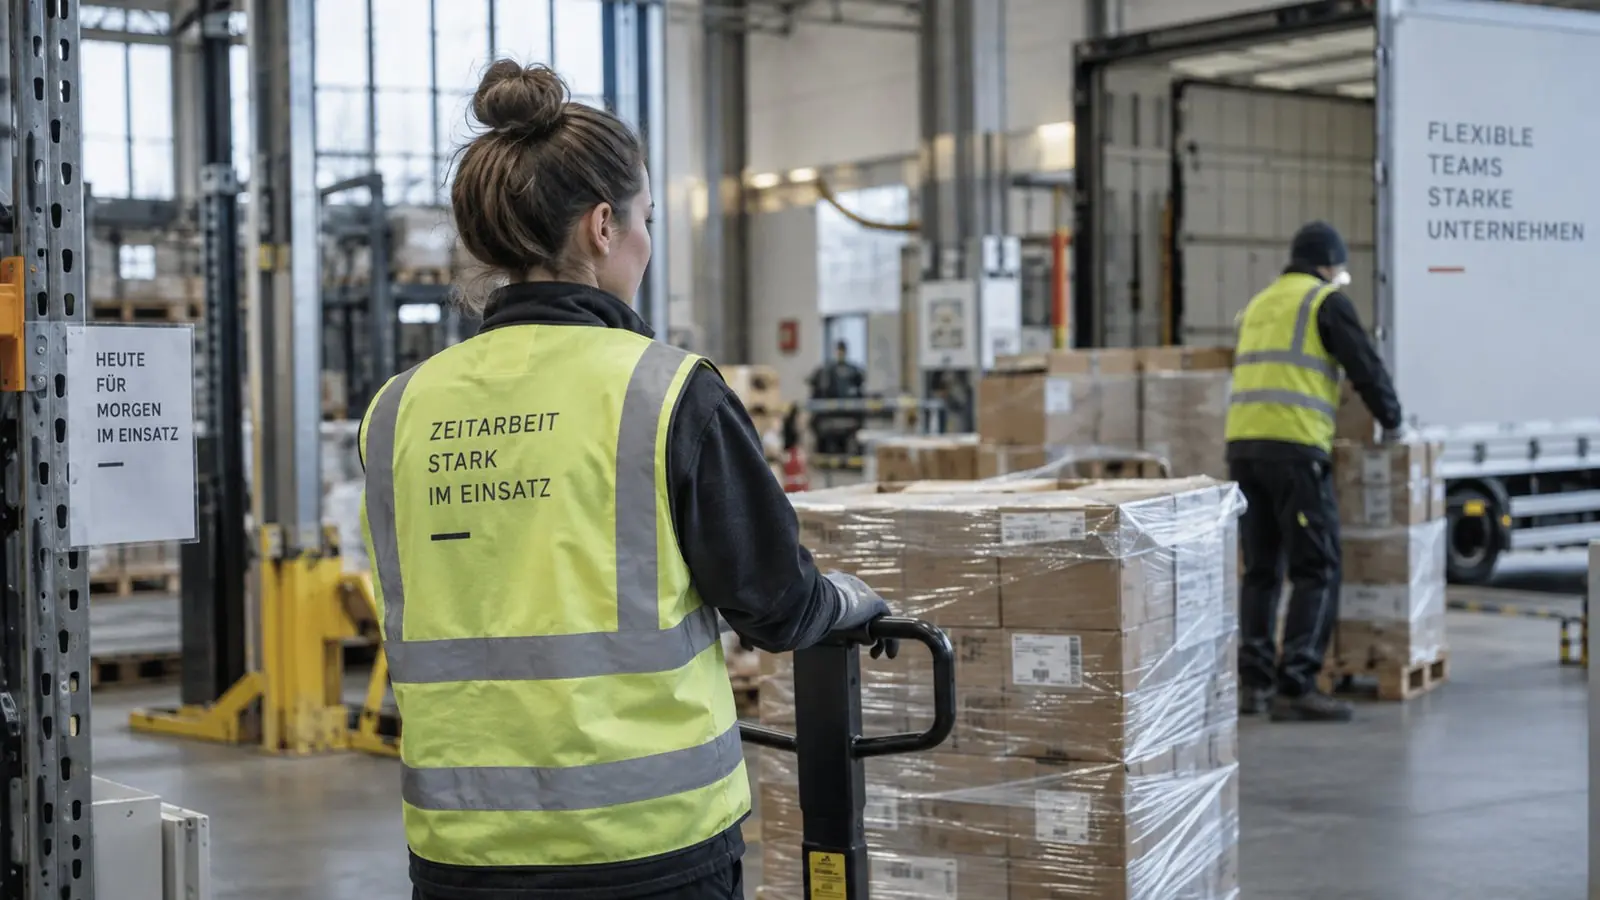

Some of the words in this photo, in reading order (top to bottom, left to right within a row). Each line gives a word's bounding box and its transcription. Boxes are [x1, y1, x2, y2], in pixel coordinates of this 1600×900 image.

[1427, 121, 1534, 148] FLEXIBLE
[1427, 153, 1503, 178] TEAMS
[1427, 186, 1514, 209] STARKE
[1427, 219, 1585, 242] UNTERNEHMEN
[96, 352, 145, 367] HEUTE
[96, 374, 126, 392] FÜR
[97, 402, 161, 417] MORGEN
[97, 428, 114, 443] IM
[119, 426, 179, 442] EINSATZ
[429, 412, 560, 441] ZEITARBEIT
[428, 449, 498, 473] STARK
[429, 485, 451, 506] IM
[461, 478, 551, 504] EINSATZ
